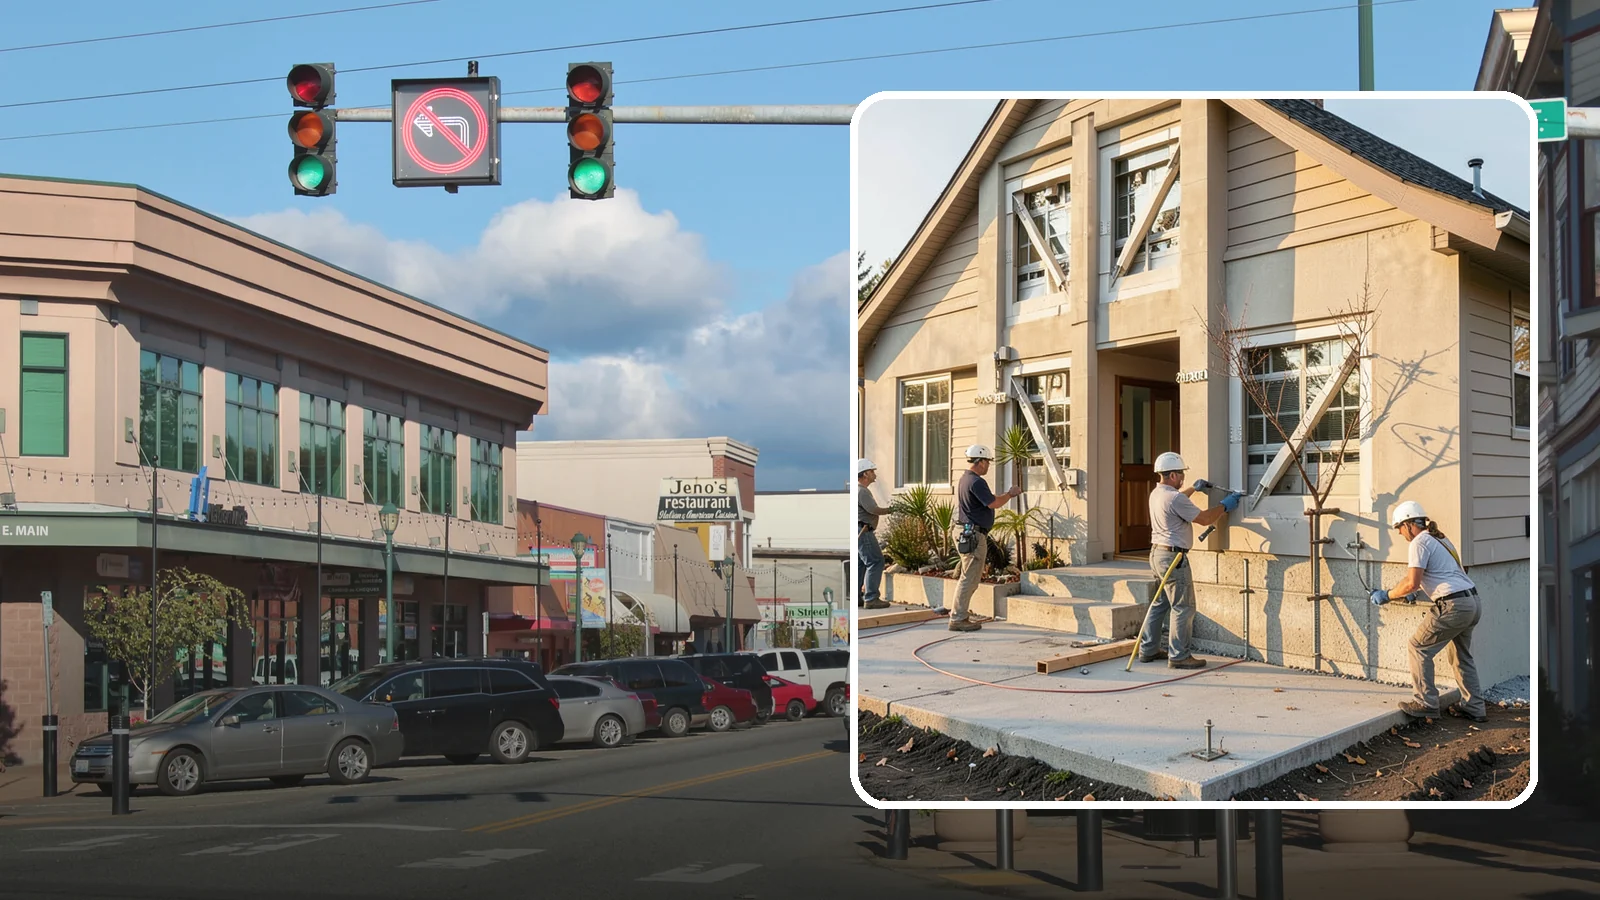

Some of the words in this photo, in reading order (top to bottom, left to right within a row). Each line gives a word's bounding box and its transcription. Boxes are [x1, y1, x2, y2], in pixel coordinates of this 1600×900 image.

[669, 480, 728, 494] Jeno's
[665, 496, 731, 509] restaurant
[658, 510, 682, 519] Italian
[685, 509, 714, 519] American
[714, 509, 738, 519] Cuisine
[2, 525, 13, 536] E.
[15, 525, 49, 536] MAIN
[797, 607, 829, 617] Street
